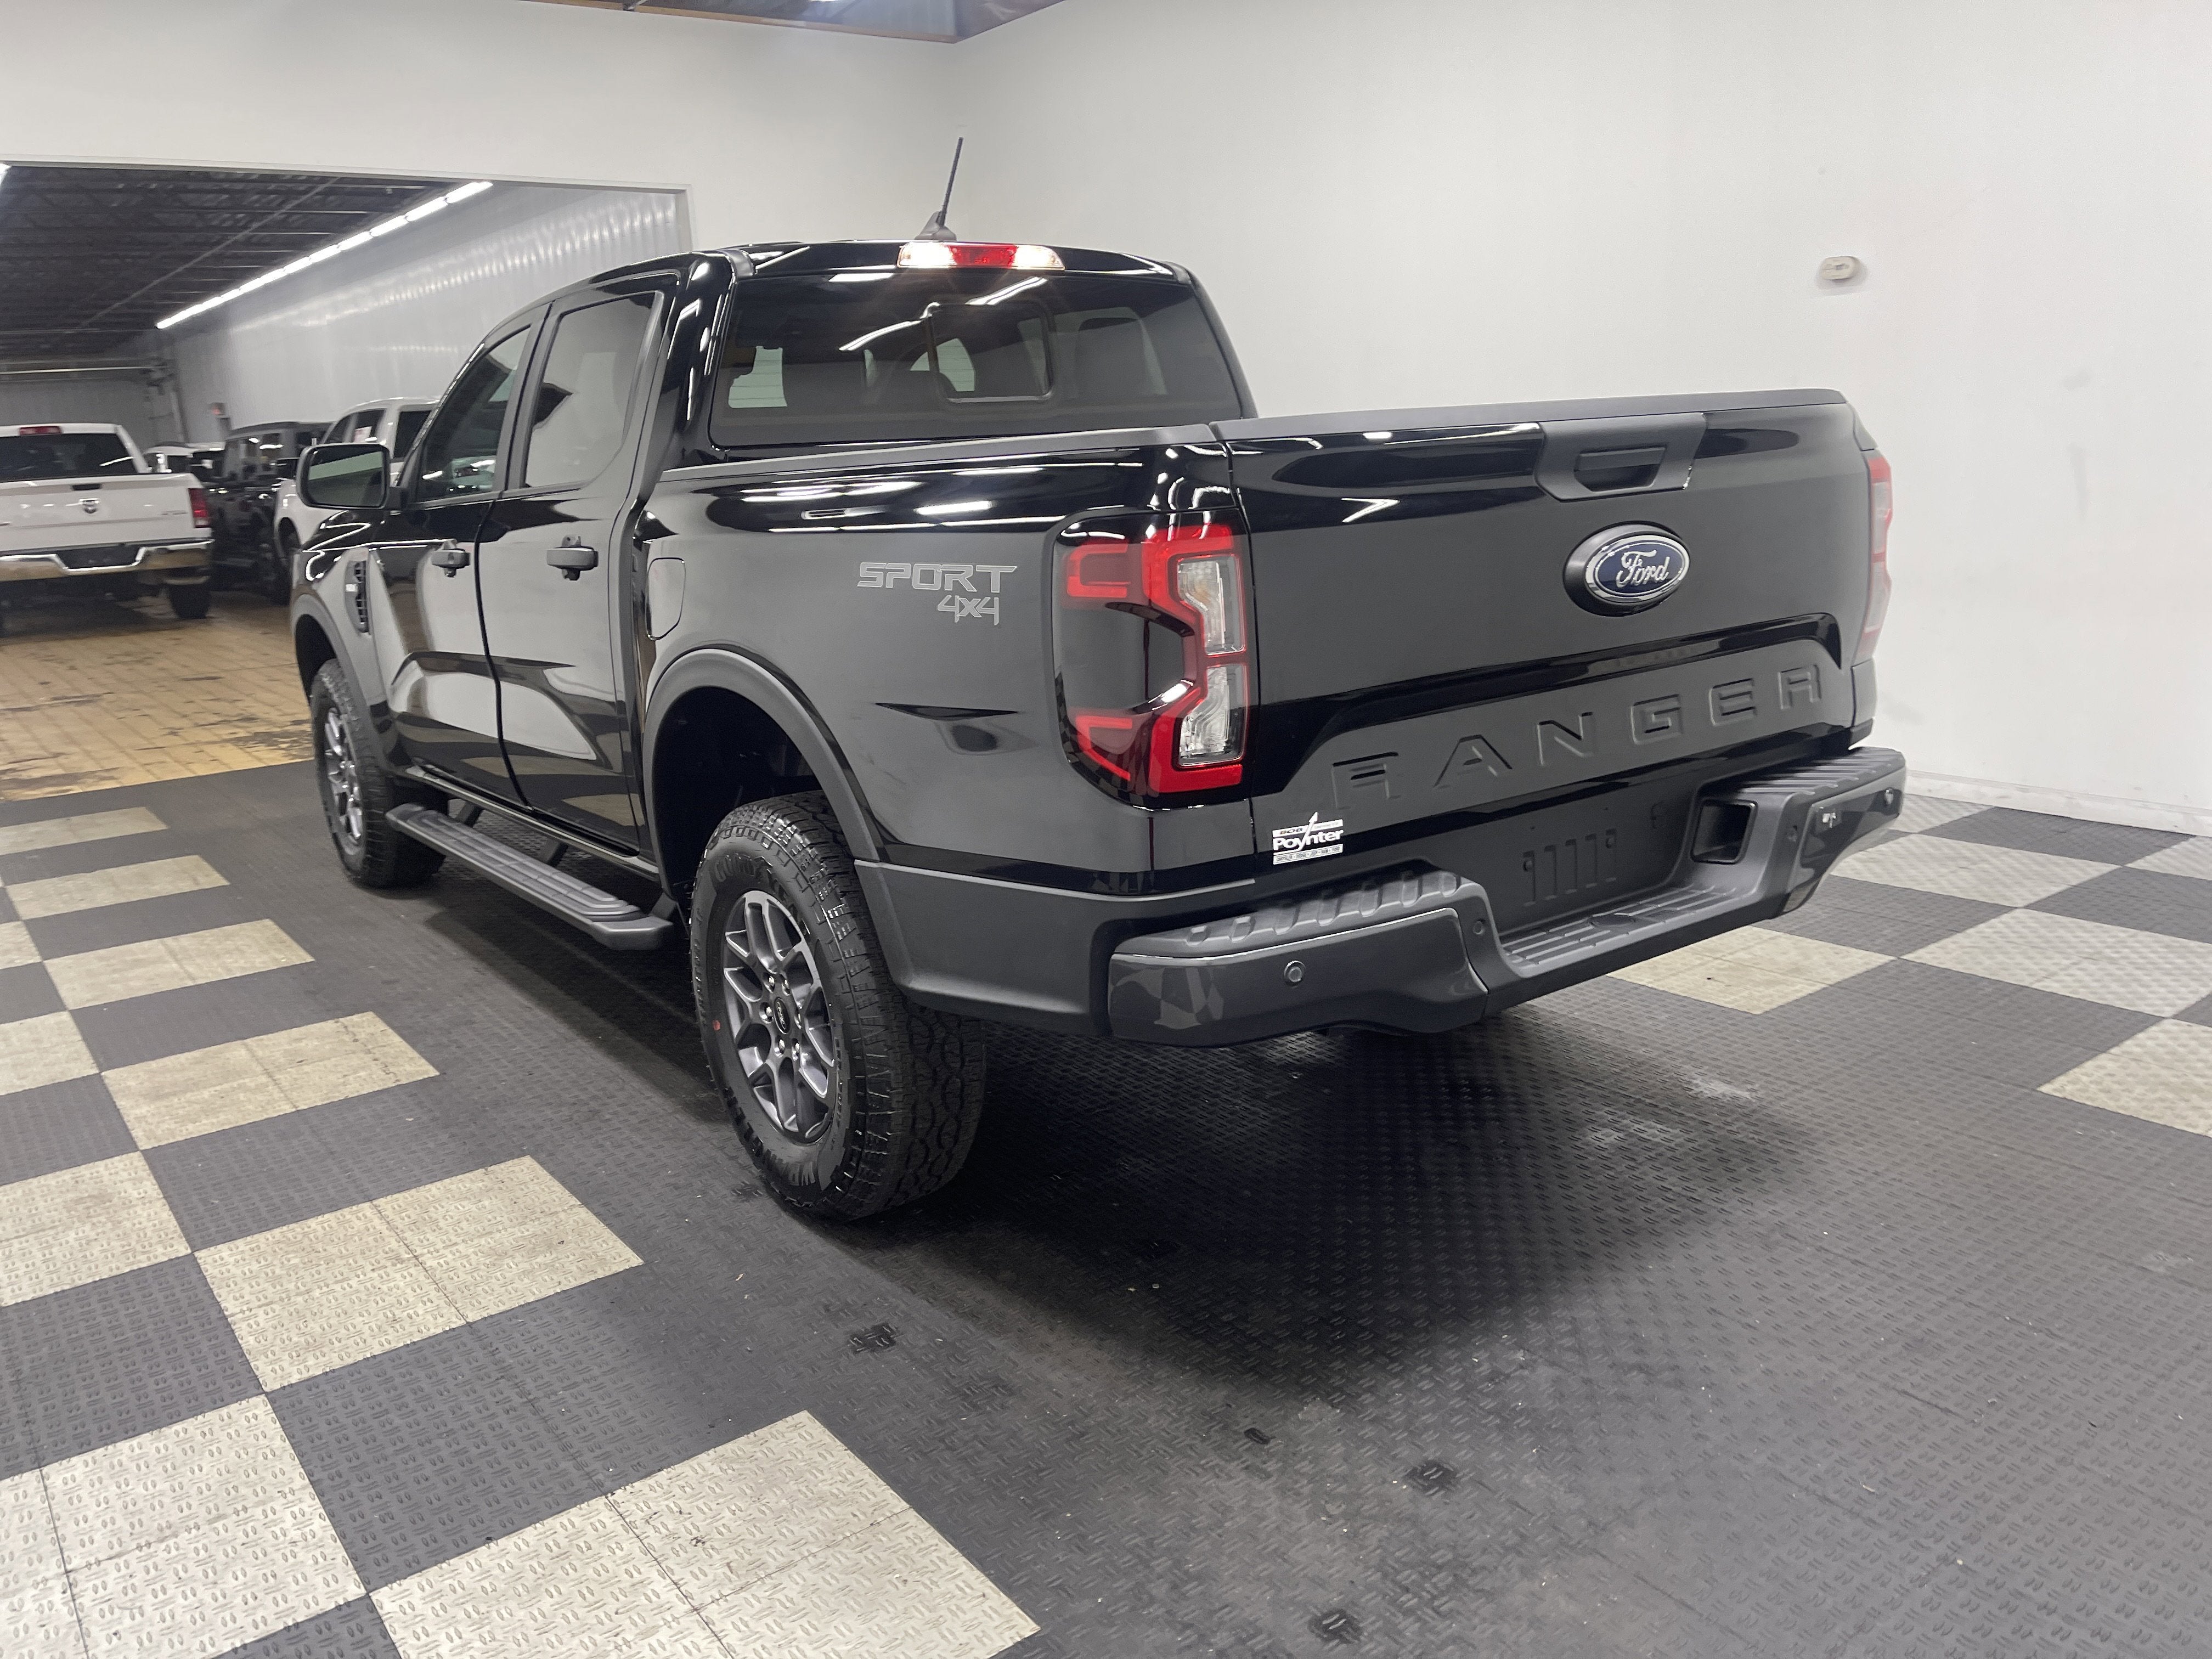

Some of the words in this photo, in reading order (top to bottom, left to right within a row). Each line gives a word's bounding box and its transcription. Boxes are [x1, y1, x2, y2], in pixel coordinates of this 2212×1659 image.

[856, 562, 1017, 593] SPORT
[1616, 550, 1671, 589] Ford
[1331, 664, 1822, 809] RANGER
[1273, 829, 1344, 852] Poynter
